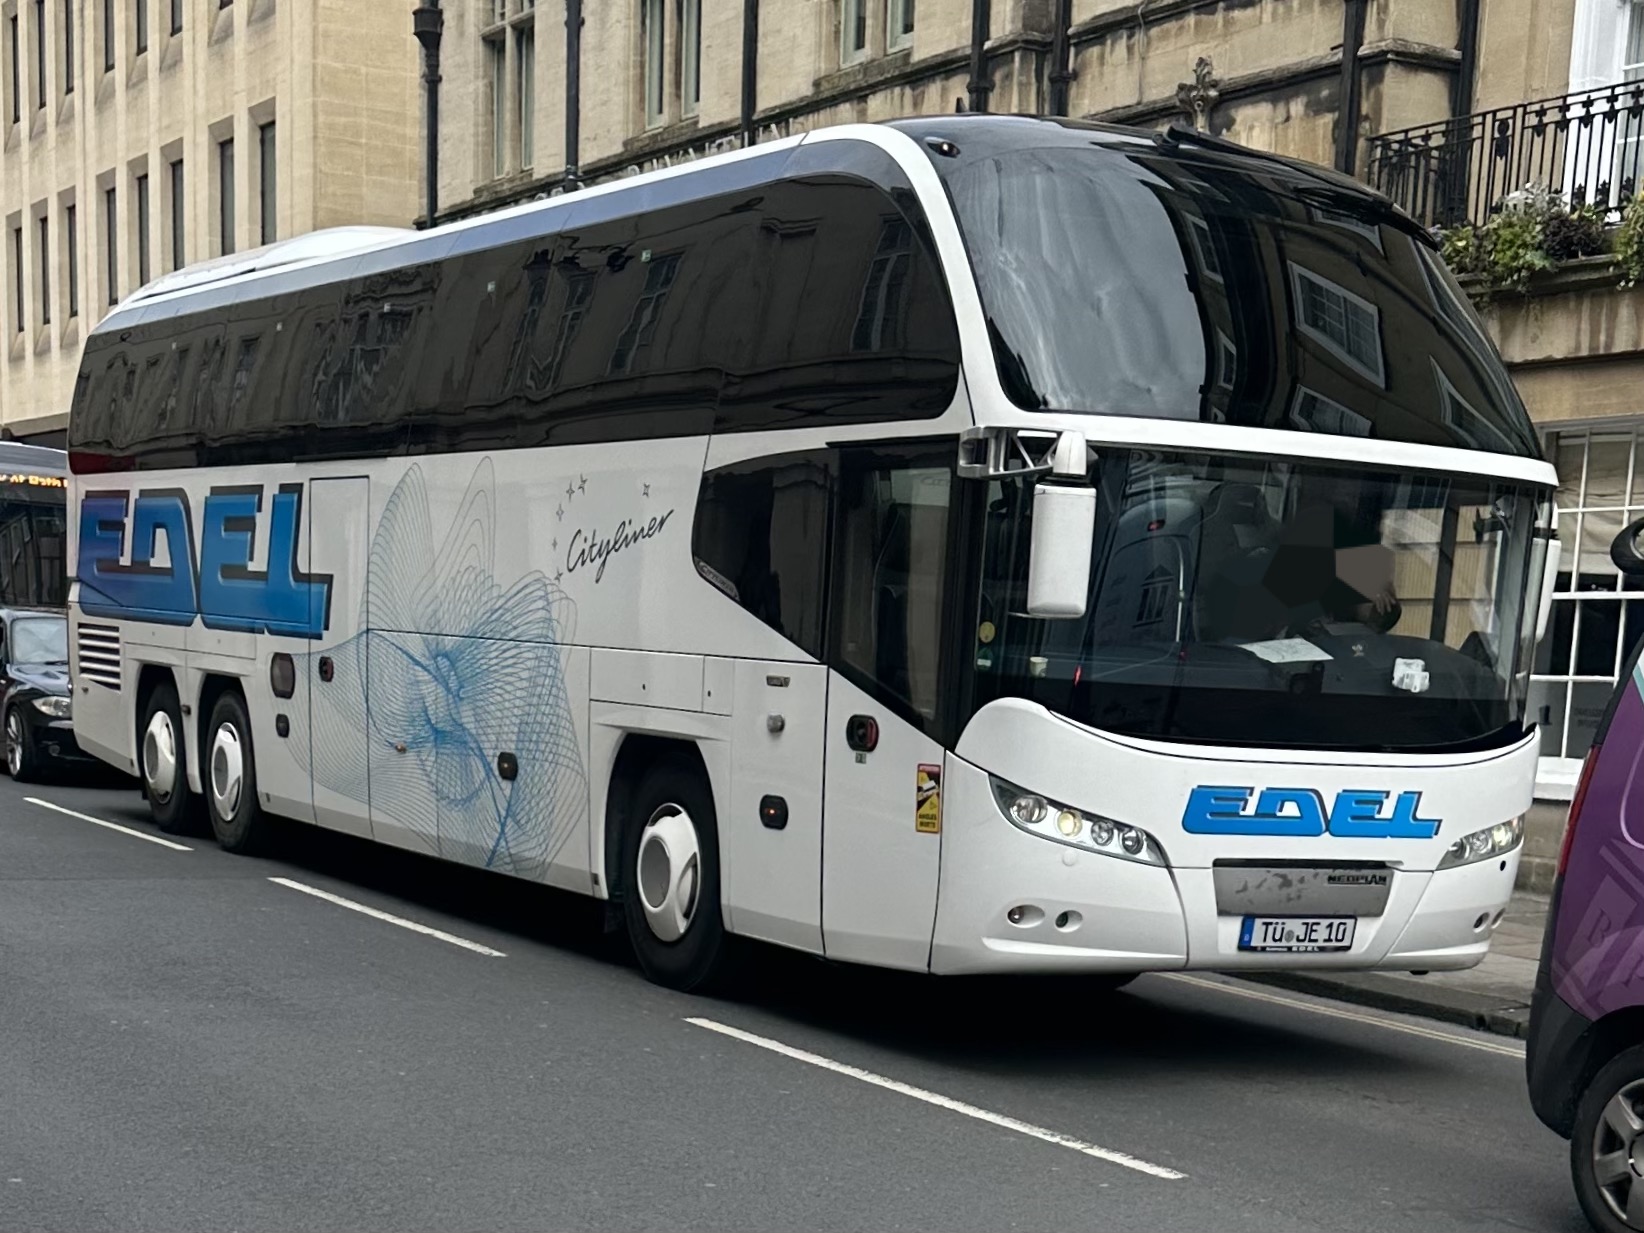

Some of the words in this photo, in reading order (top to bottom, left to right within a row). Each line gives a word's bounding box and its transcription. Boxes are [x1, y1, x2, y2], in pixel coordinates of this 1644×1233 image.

[77, 482, 334, 641] EDEL
[566, 508, 675, 584] Cityliner
[1181, 785, 1443, 839] EDEL
[1261, 921, 1286, 943] TÜ
